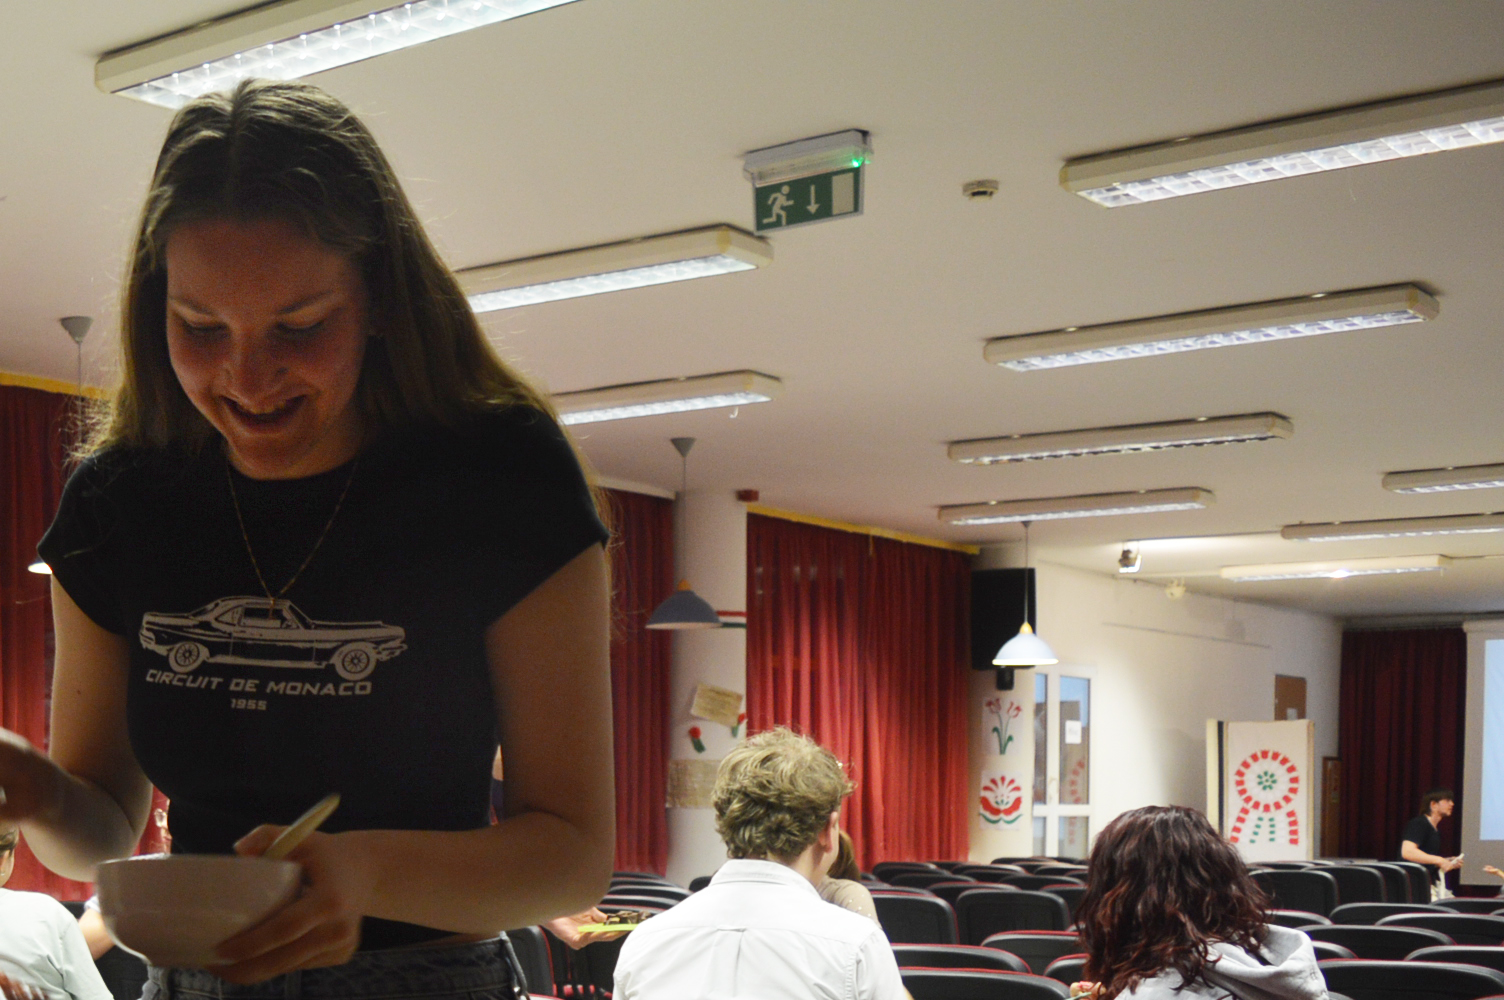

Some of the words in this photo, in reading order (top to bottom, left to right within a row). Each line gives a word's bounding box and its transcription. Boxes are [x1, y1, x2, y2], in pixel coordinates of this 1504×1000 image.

[146, 669, 223, 690] CIRCUIT
[229, 678, 260, 692] DE
[266, 681, 372, 696] MONACO
